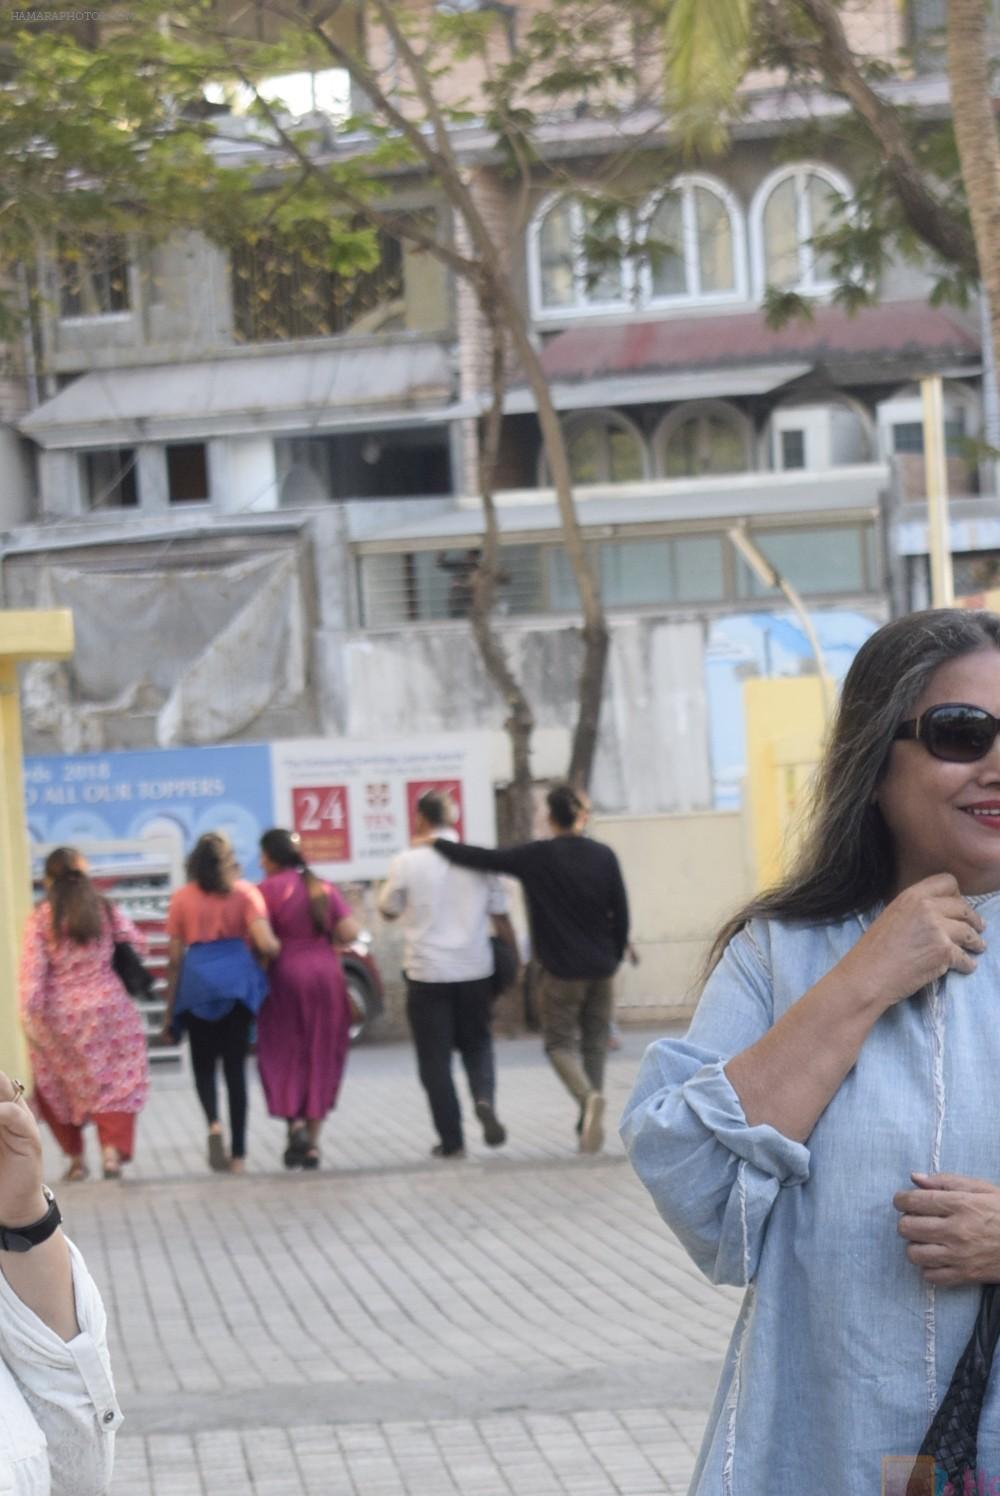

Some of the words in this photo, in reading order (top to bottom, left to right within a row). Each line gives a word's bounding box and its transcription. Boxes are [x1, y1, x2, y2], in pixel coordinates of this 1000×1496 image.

[44, 784, 80, 806] ALL
[83, 781, 132, 803] OUR
[138, 777, 225, 800] TOPPERS
[299, 789, 344, 832] 24
